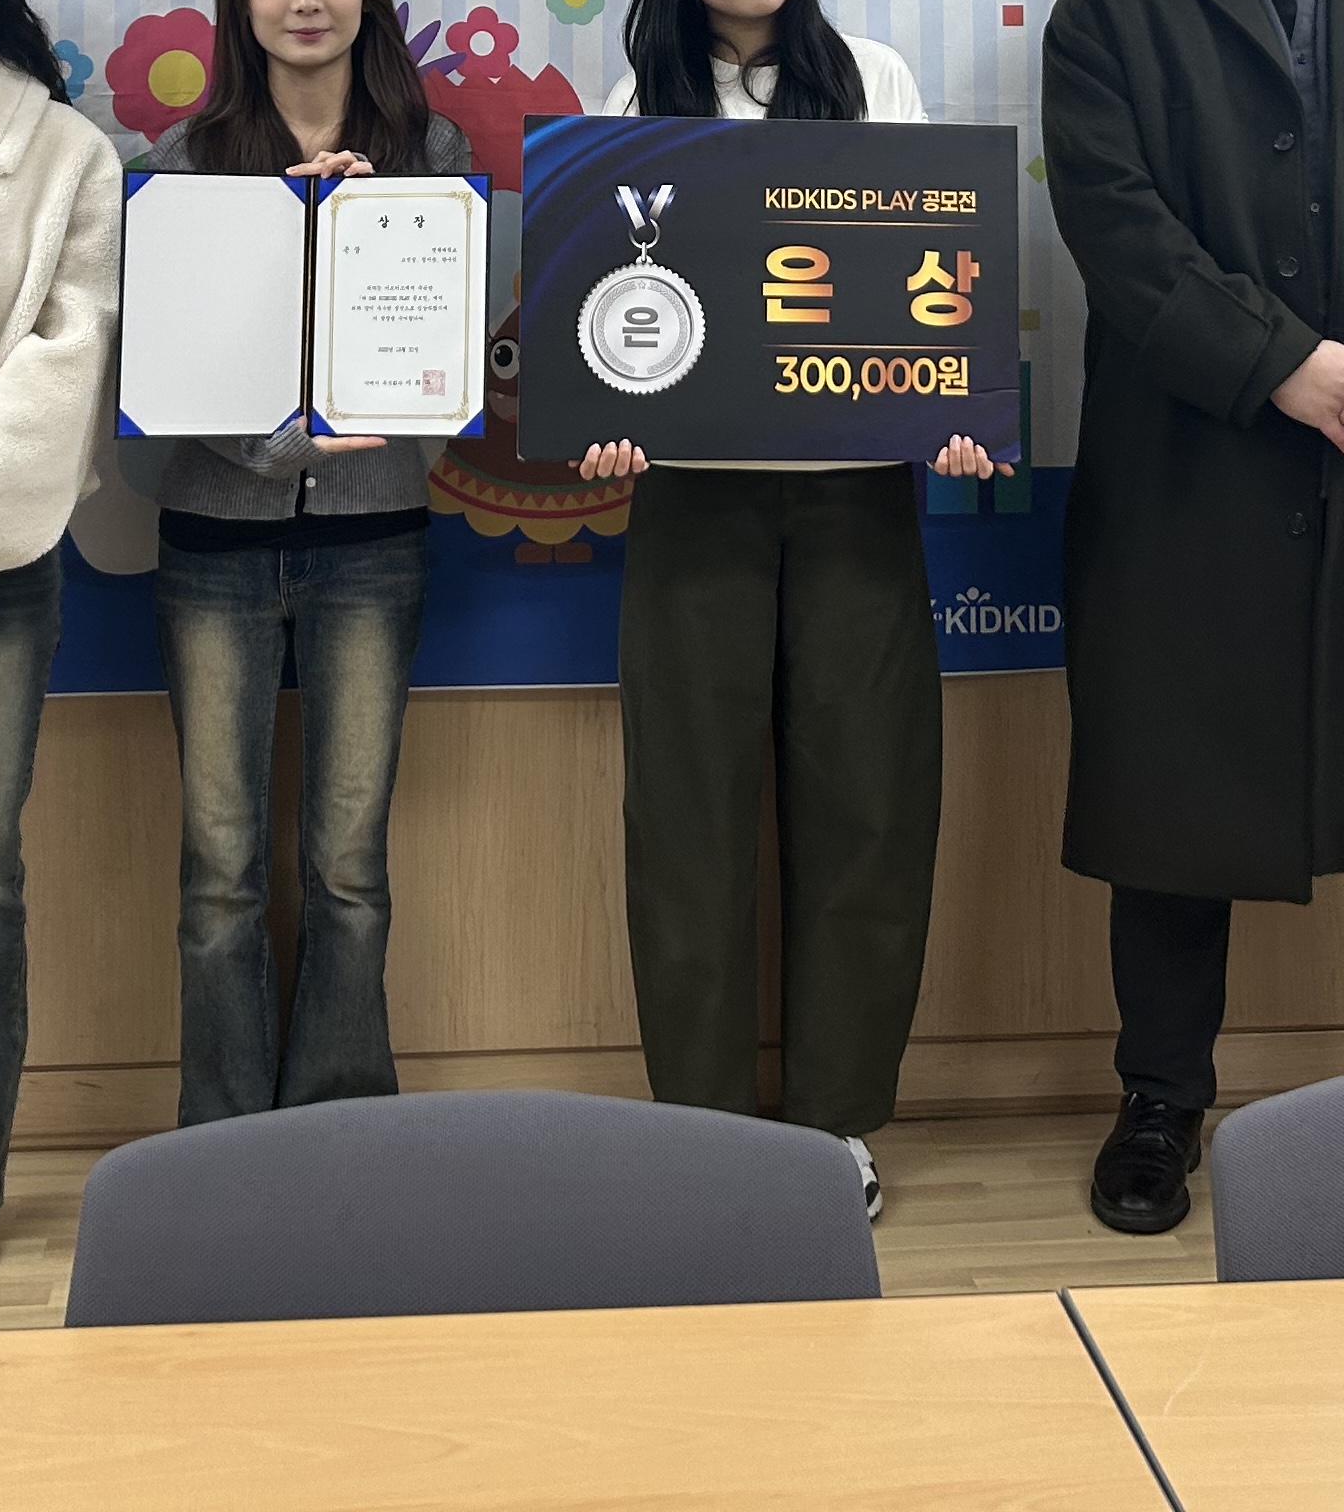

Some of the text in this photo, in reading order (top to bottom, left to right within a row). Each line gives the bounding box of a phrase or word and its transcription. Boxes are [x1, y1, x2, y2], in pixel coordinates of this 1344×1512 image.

[764, 187, 977, 214] KIDKIDS PLAY 공모전
[762, 244, 981, 327] 은 상
[622, 306, 661, 349] 은
[774, 356, 969, 401] 300,000원
[944, 604, 1065, 635] KIDKID
